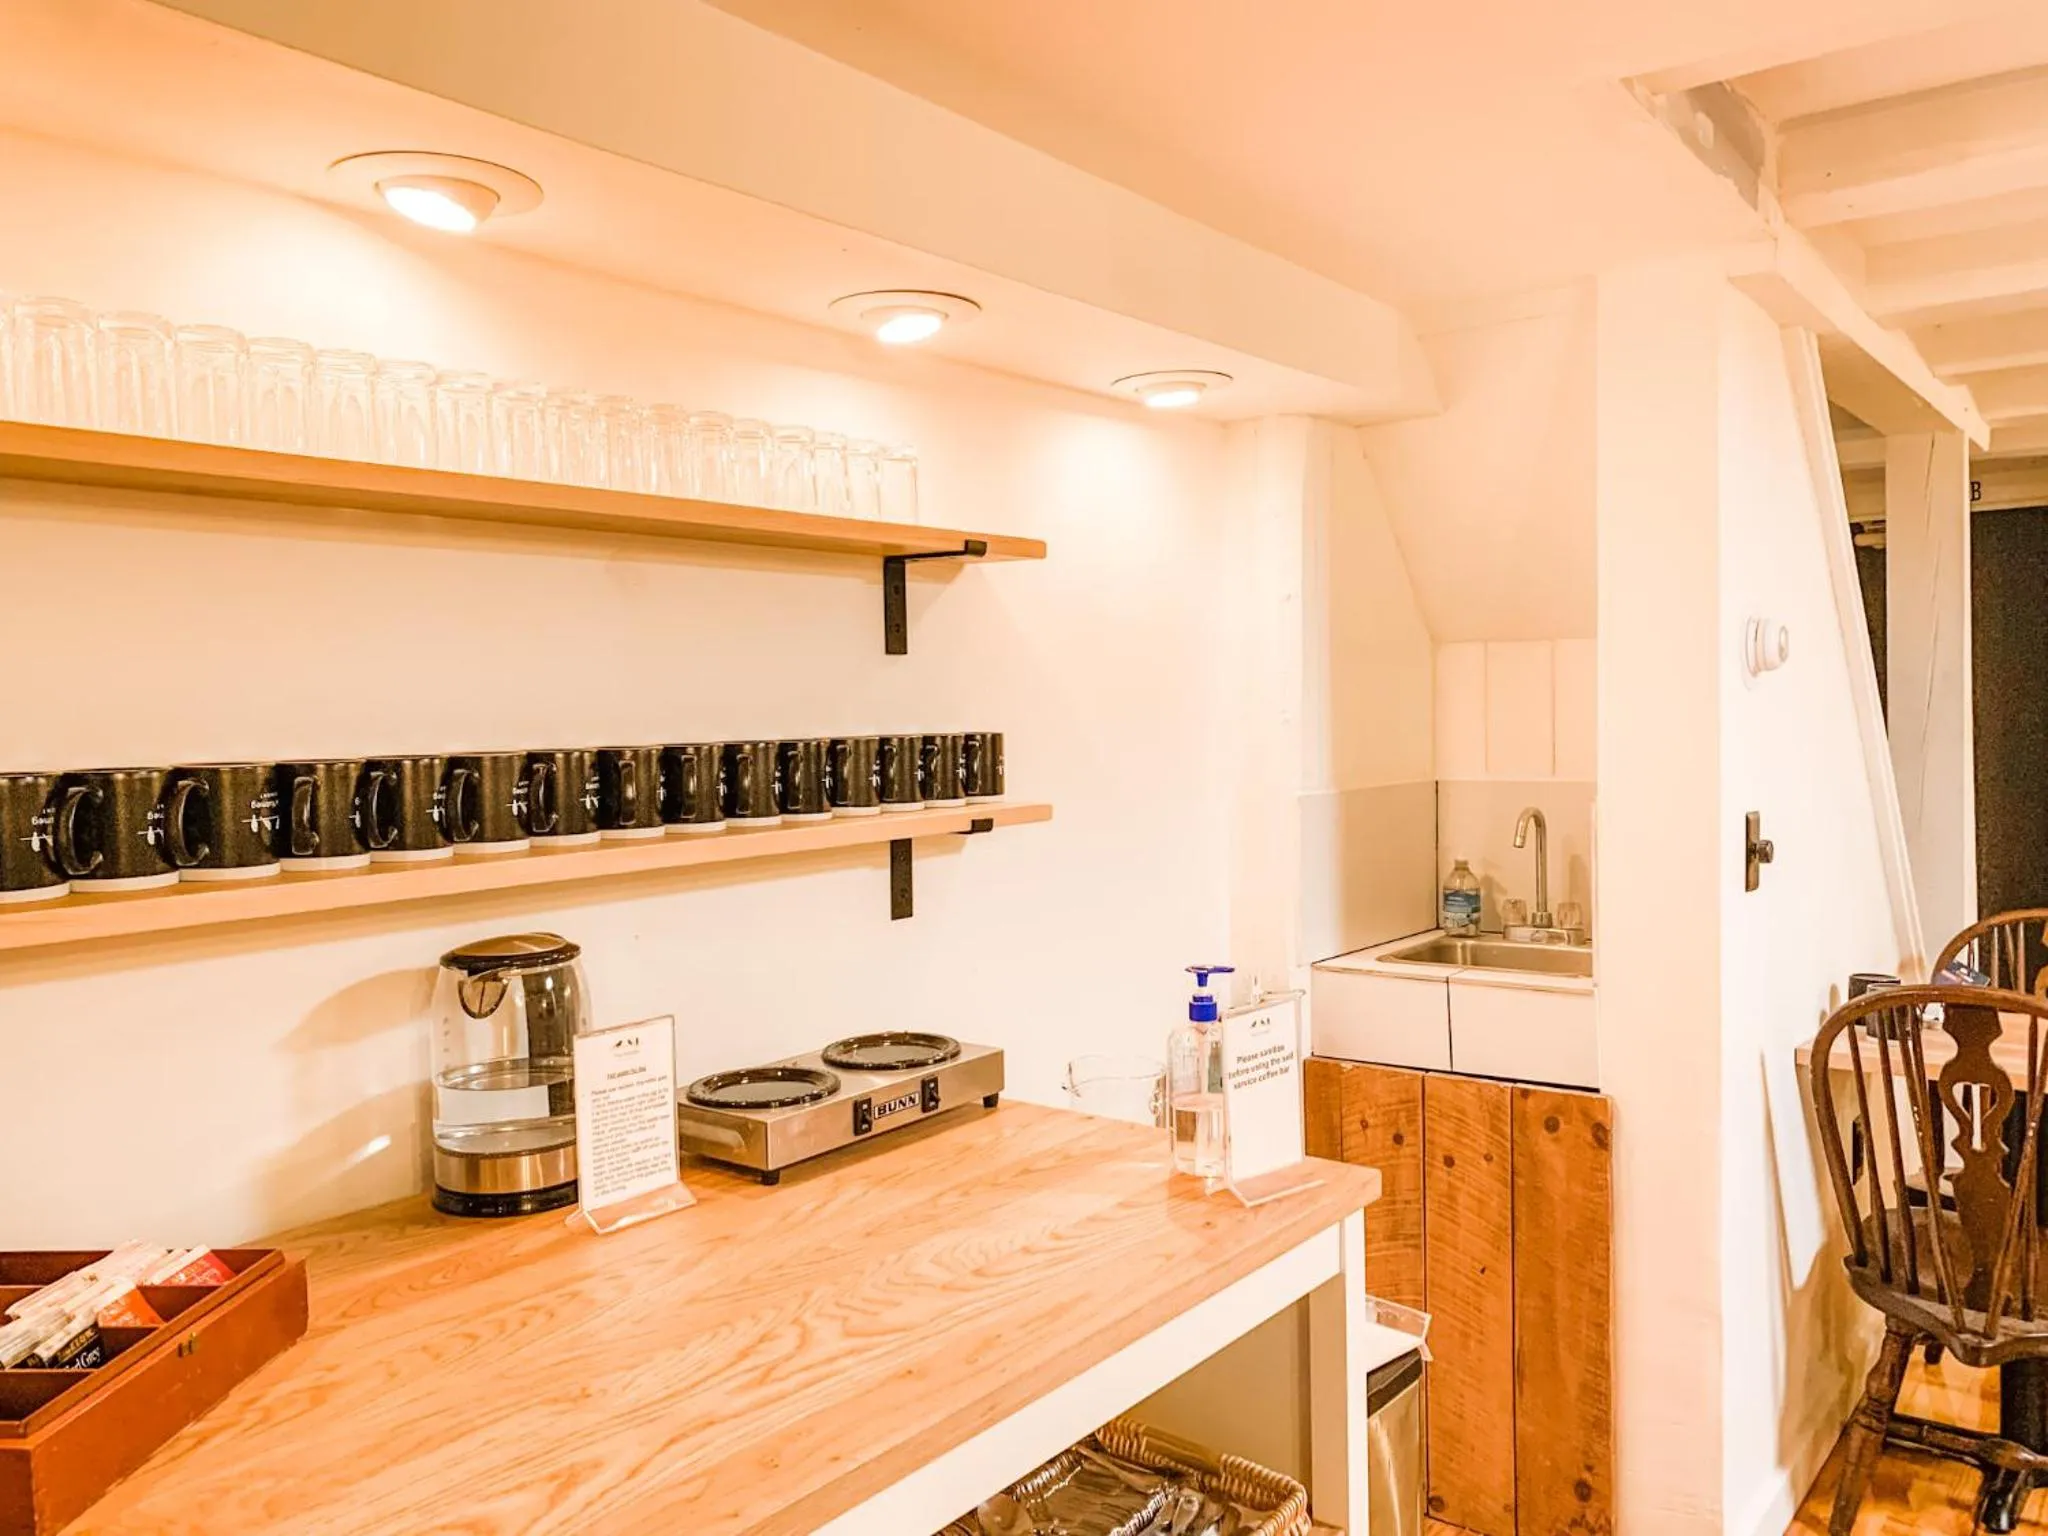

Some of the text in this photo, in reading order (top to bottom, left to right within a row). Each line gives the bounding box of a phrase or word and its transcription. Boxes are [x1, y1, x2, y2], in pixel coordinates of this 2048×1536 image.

[1970, 481, 1981, 502] B
[1236, 1053, 1258, 1064] Please
[1270, 1057, 1280, 1066] the
[1259, 1071, 1278, 1082] coffee
[1279, 1066, 1289, 1074] bar
[876, 1093, 918, 1118] BUNN
